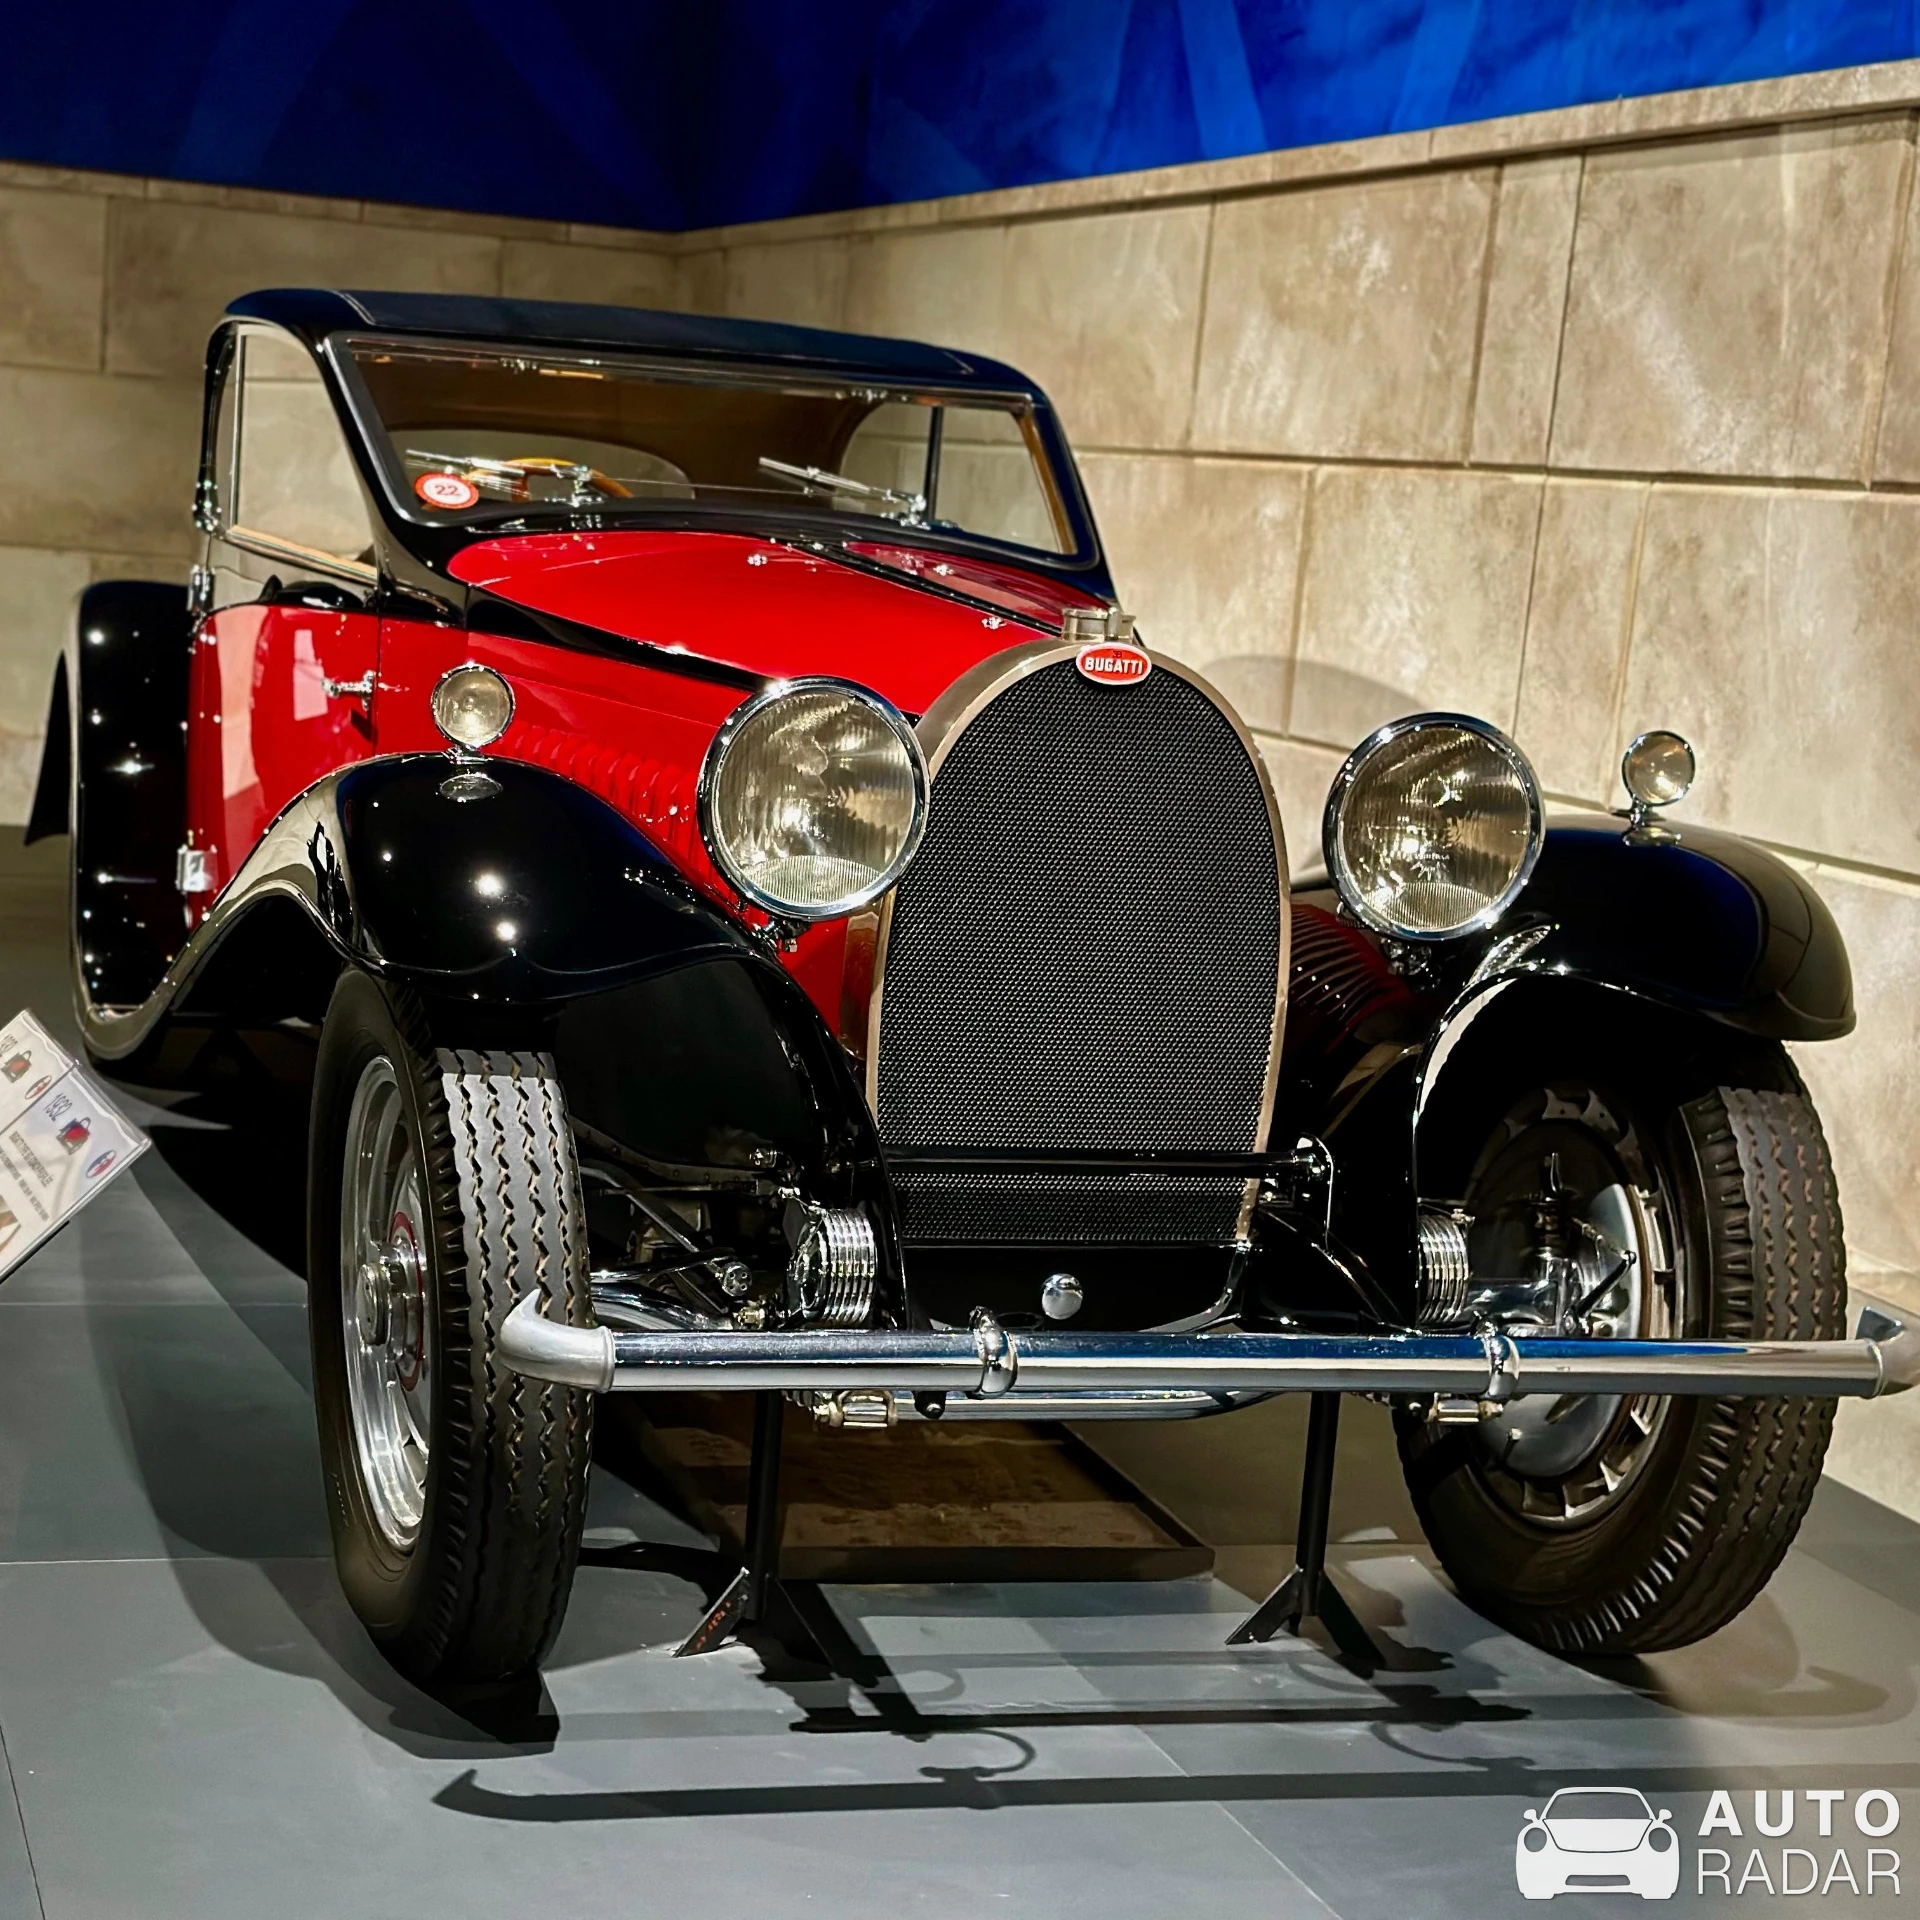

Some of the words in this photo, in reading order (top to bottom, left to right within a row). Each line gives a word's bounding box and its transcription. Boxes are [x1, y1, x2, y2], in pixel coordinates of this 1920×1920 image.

[434, 484, 461, 496] 22
[1084, 656, 1144, 675] BUGATTI
[44, 1092, 73, 1122] 1932
